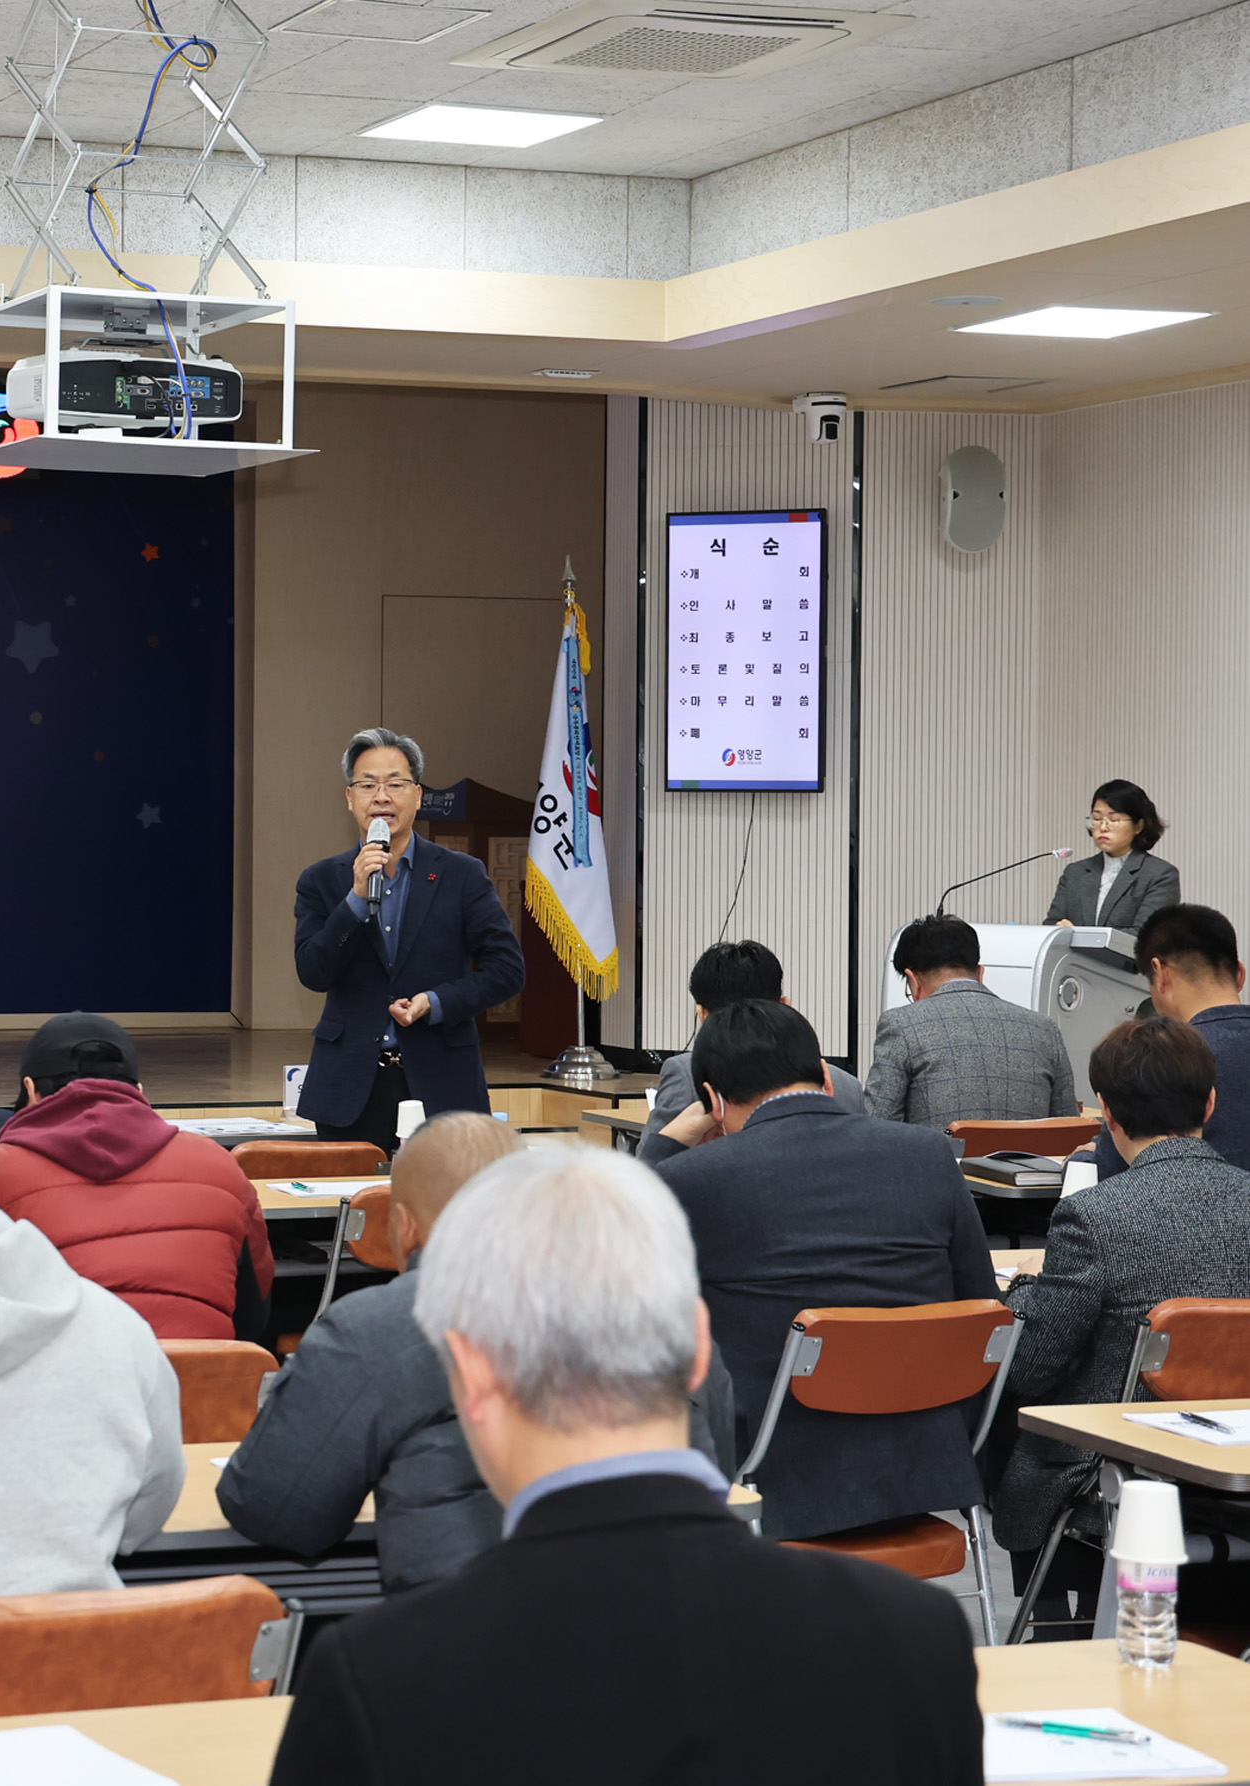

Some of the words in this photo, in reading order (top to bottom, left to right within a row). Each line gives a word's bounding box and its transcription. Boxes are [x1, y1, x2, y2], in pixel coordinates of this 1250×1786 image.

[709, 537, 726, 558] 식
[762, 536, 780, 556] 순
[737, 748, 763, 761] 영양군
